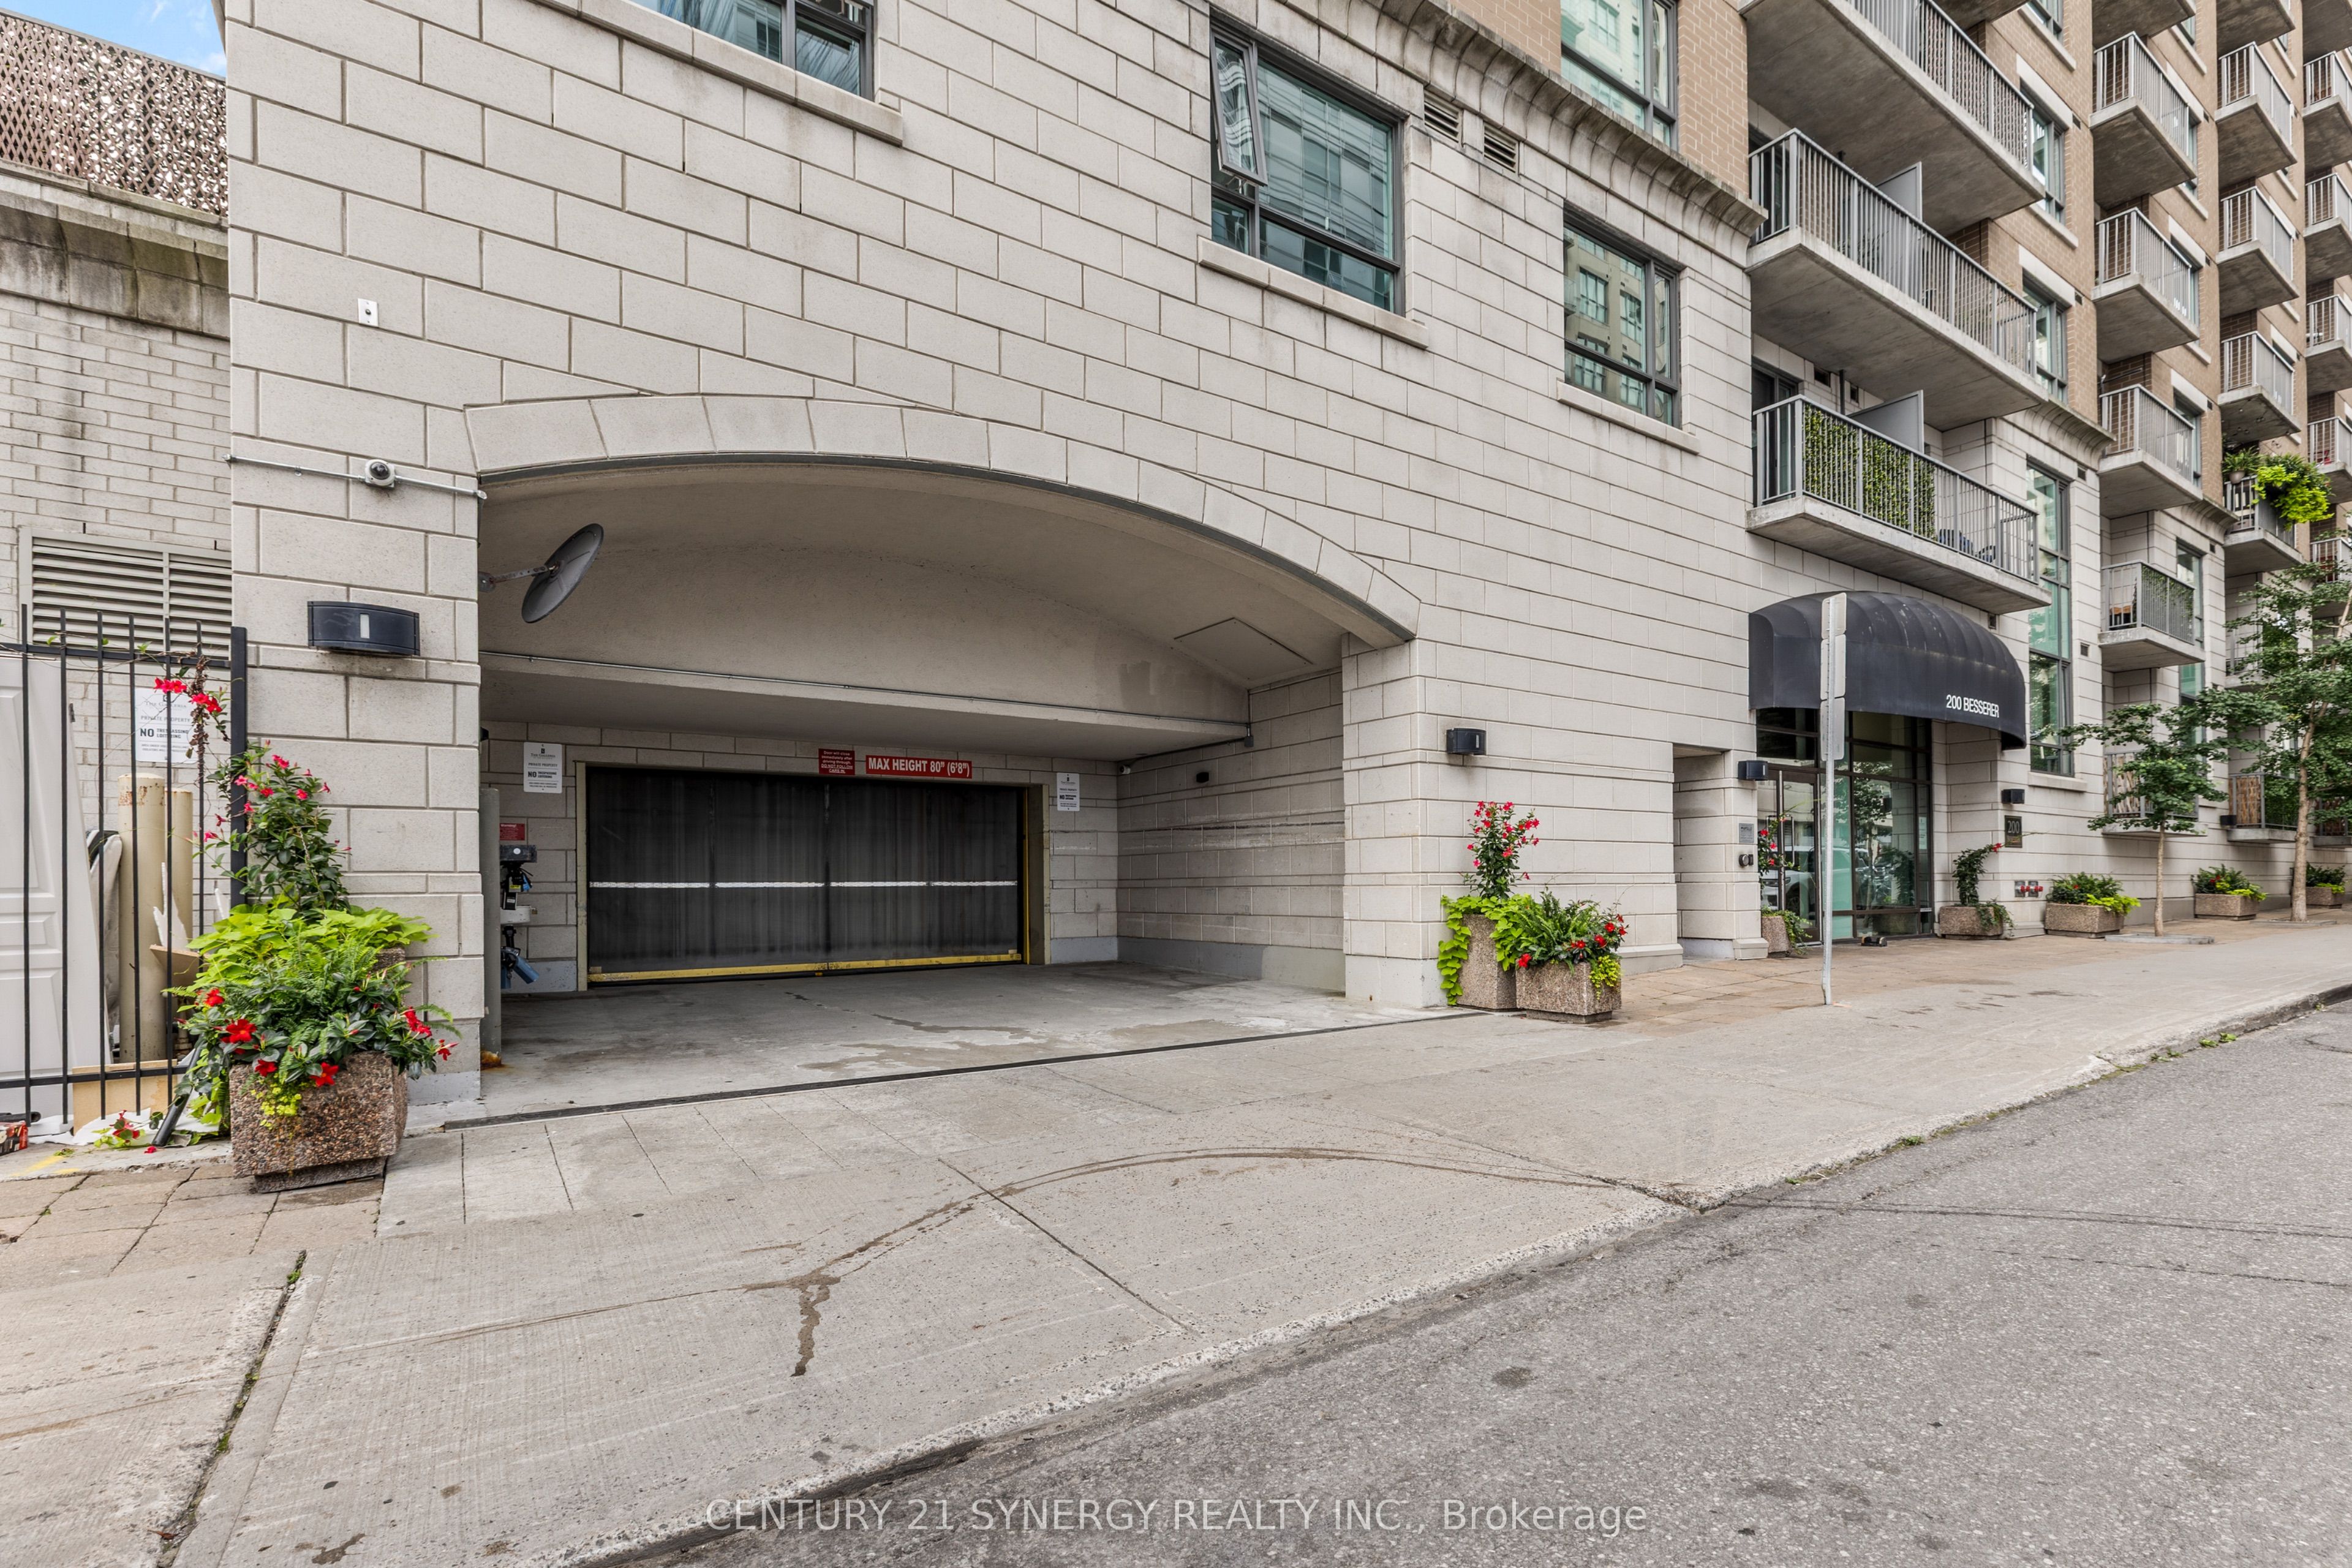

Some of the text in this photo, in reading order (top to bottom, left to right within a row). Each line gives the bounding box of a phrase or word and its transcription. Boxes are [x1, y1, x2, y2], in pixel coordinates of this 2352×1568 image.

[1946, 694, 1999, 718] 200 BESSERER
[140, 728, 154, 737] NO
[869, 758, 890, 770] MAX
[892, 758, 927, 772] HEIGHT
[2008, 820, 2020, 834] 200
